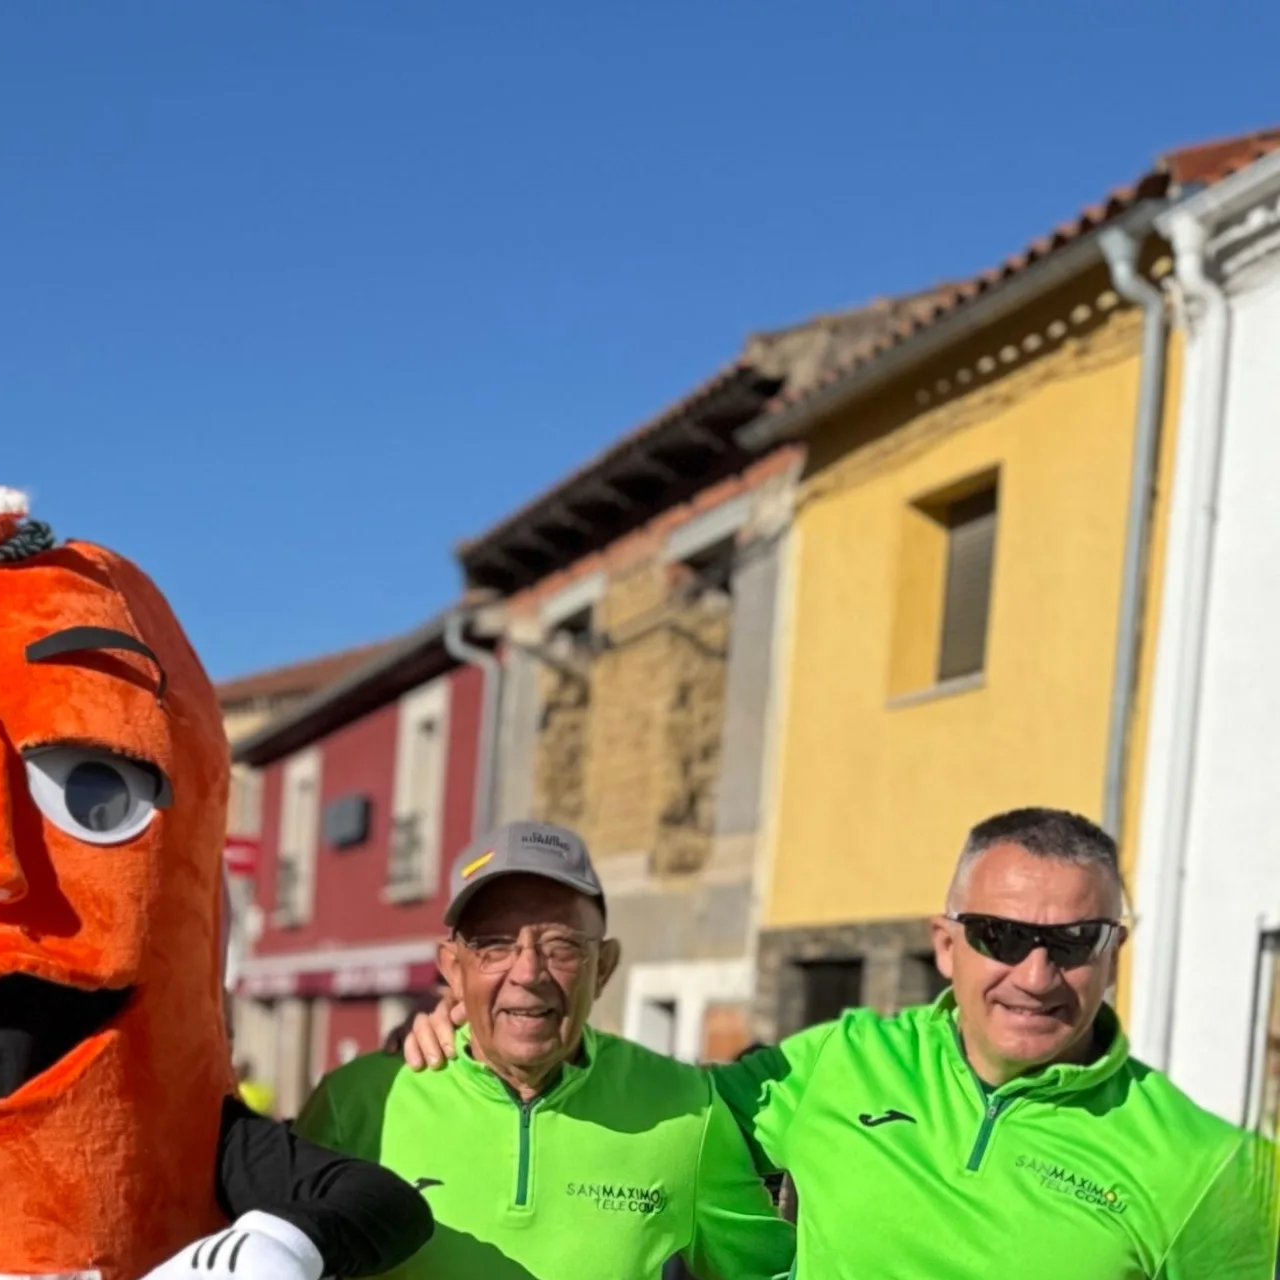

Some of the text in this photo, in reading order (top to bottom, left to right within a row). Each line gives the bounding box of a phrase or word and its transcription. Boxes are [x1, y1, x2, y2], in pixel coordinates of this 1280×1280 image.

[1015, 1155, 1118, 1204] SANMAXIMO
[566, 1182, 661, 1204] SANMAXIMO
[594, 1199, 656, 1214] TELECOM
